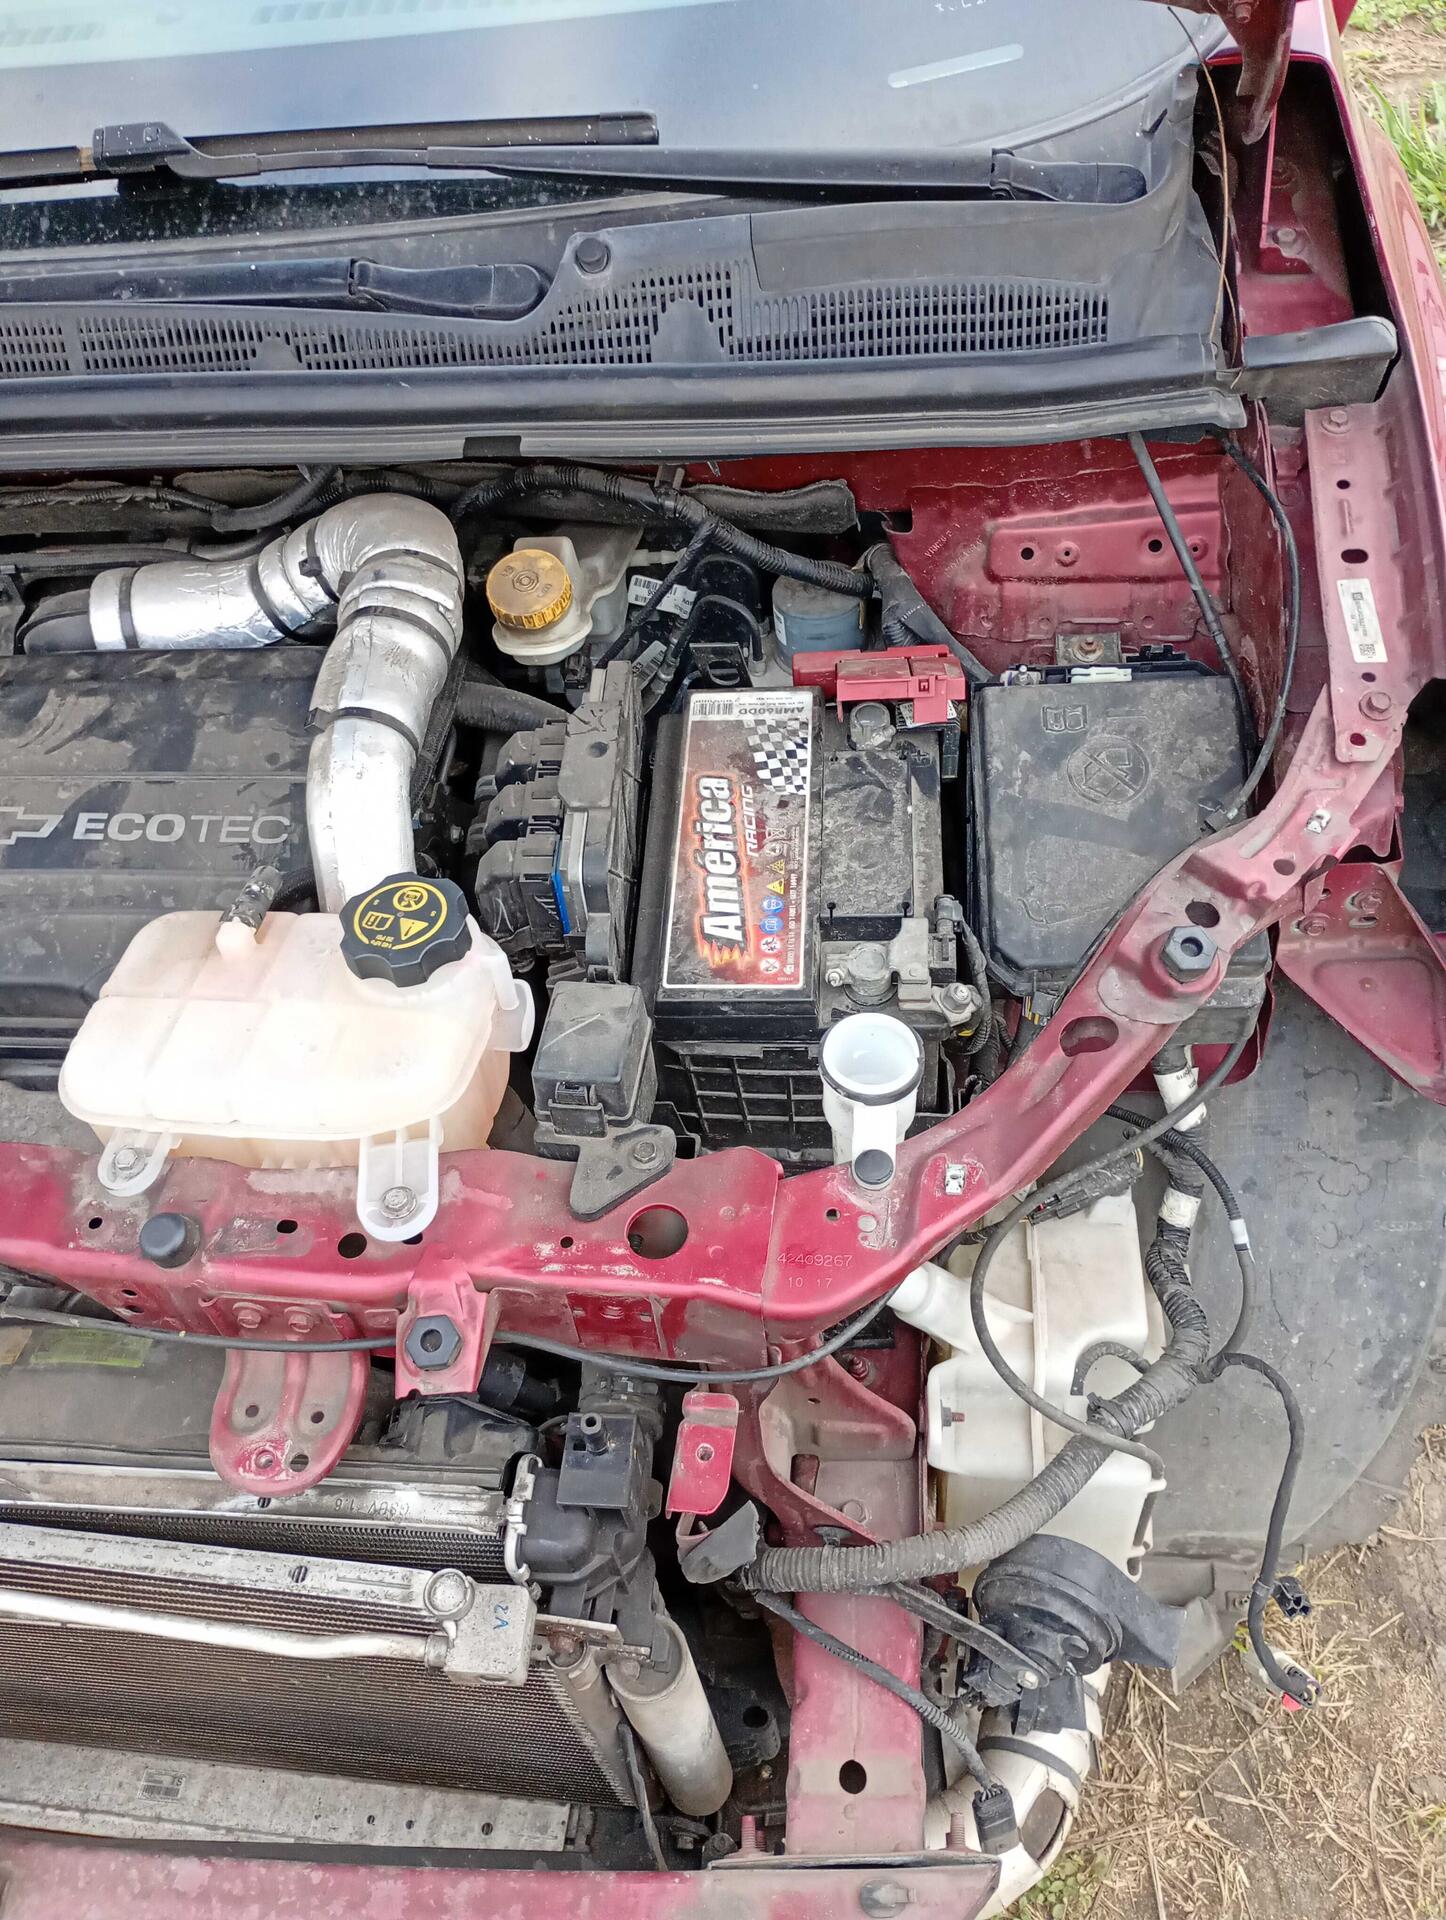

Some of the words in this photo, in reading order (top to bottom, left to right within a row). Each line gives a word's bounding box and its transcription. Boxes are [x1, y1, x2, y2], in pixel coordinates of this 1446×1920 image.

[738, 706, 805, 716] AMR60DD
[72, 812, 291, 844] ECOTEC
[741, 785, 759, 857] RACING
[696, 777, 744, 942] América
[788, 1276, 804, 1289] 10
